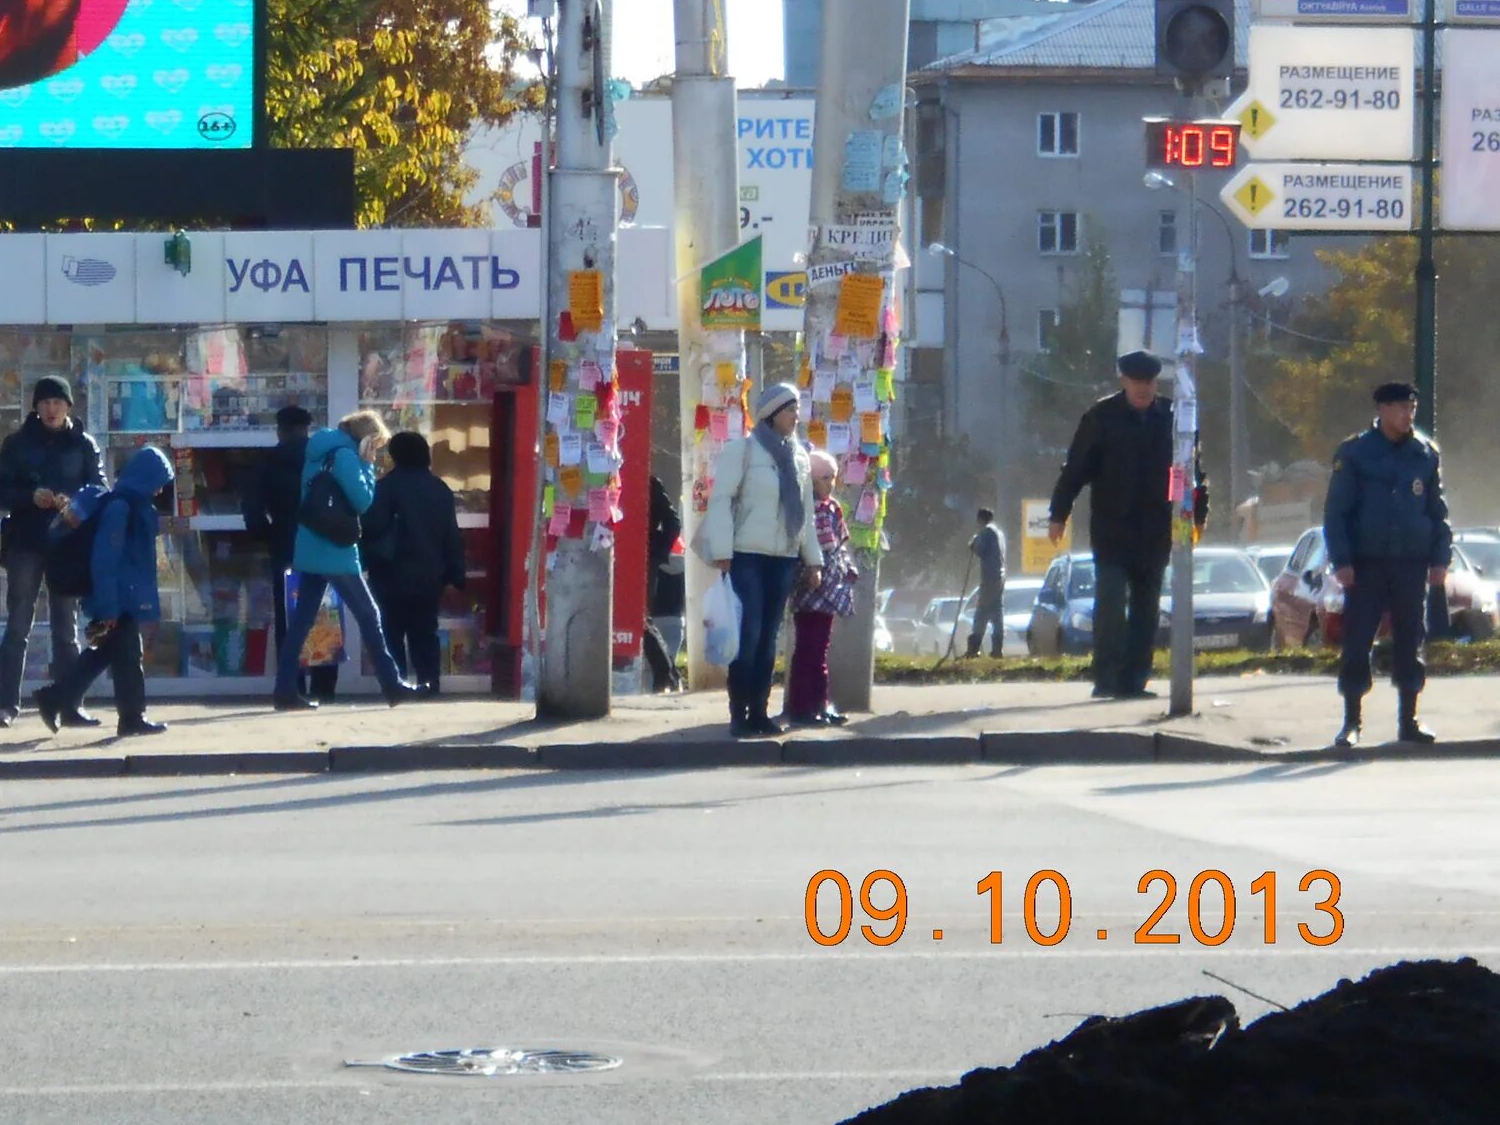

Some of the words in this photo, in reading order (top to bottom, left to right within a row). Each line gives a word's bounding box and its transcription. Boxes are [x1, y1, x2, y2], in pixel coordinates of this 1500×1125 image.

[1279, 66, 1401, 82] РАЗМЕЩЕНИЕ
[1279, 89, 1401, 110] 262-91-80
[1283, 174, 1403, 191] РАЗМЕЩЕНИЕ
[1283, 199, 1404, 220] 262-91-80
[226, 258, 311, 293] УФА
[339, 255, 521, 292] ПЕЧАТЬ
